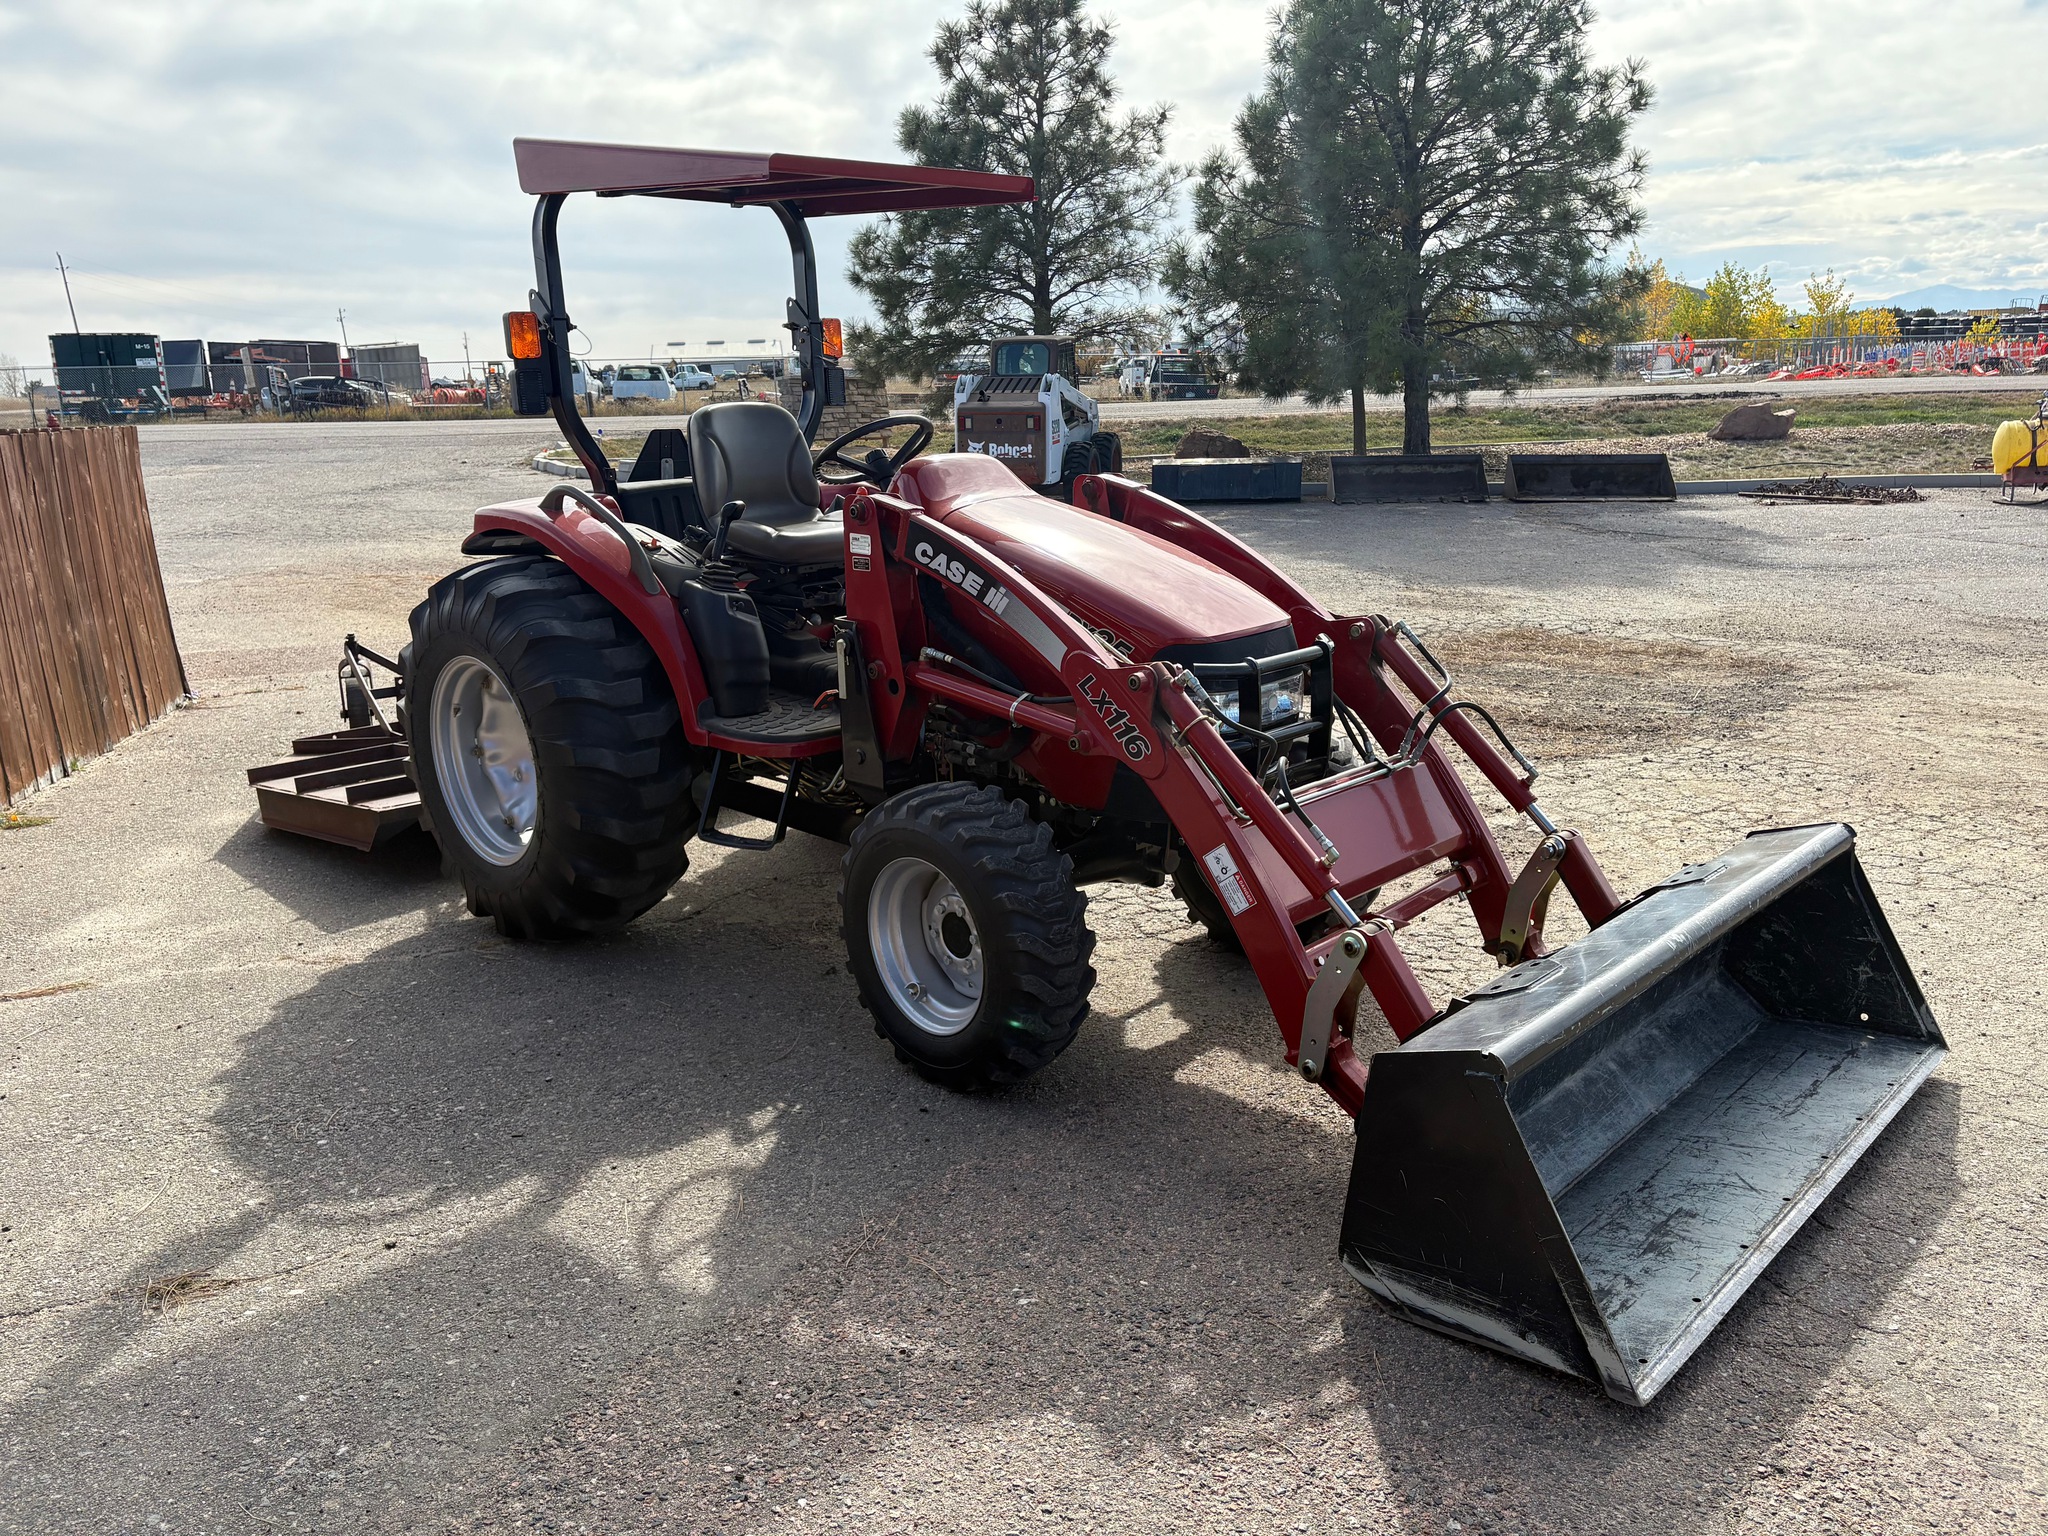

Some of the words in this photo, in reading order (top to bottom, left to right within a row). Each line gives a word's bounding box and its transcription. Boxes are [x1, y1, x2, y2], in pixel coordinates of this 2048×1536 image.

[988, 443, 1034, 458] Bobcat
[914, 541, 984, 597] CASE
[1076, 672, 1152, 761] LX116
[1239, 880, 1253, 902] DANGER
